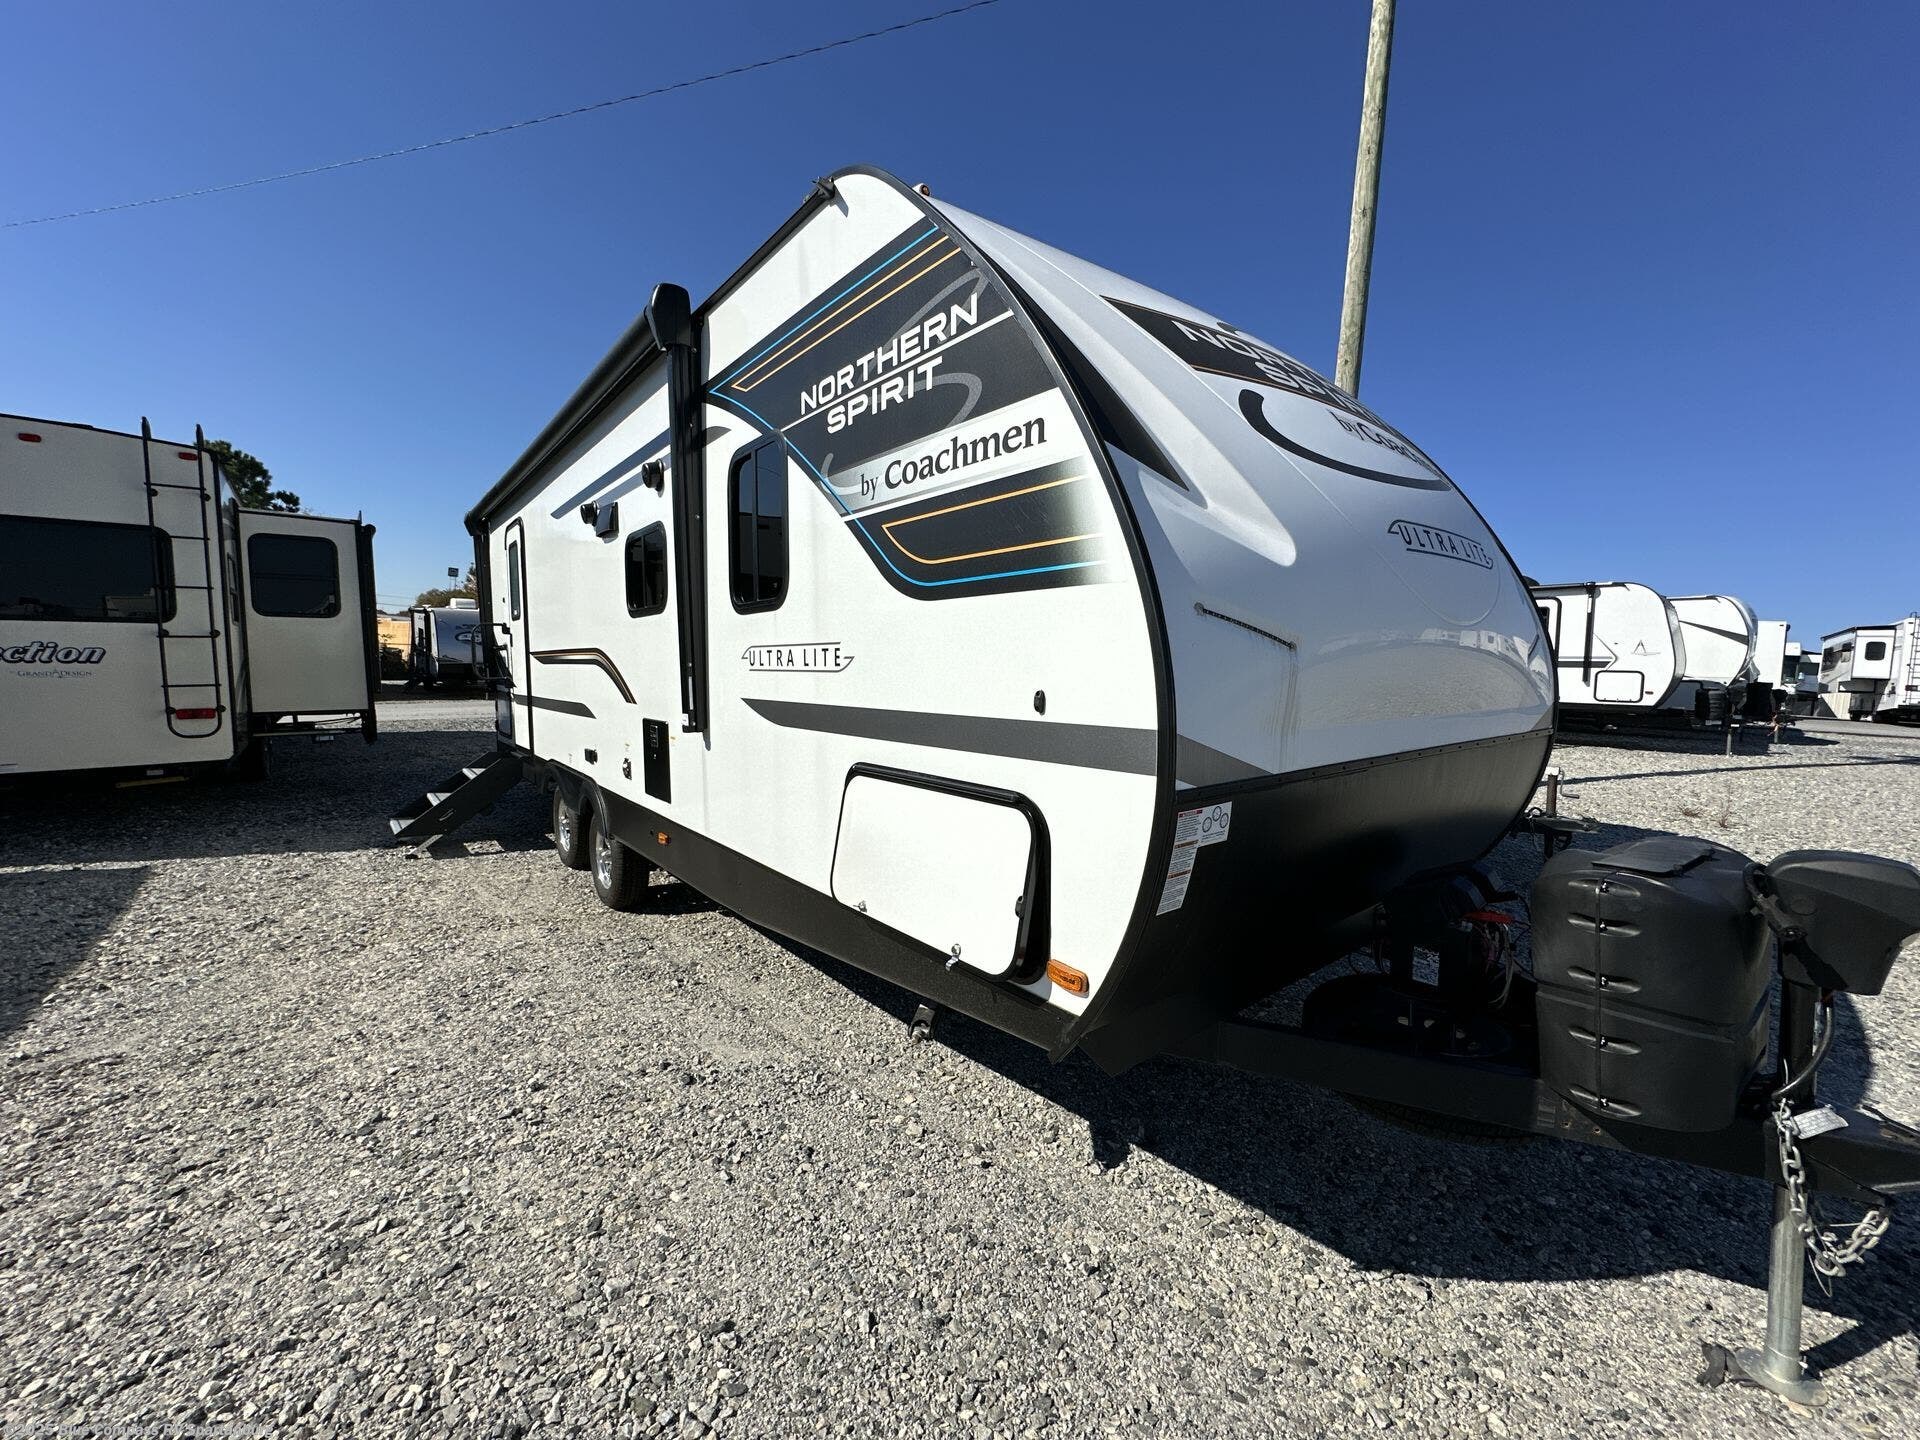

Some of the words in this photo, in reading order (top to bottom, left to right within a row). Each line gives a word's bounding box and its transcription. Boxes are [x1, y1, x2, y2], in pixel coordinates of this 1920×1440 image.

[801, 292, 978, 415] NORTHERN
[827, 356, 943, 434] SPIRIT
[861, 474, 878, 501] by
[884, 416, 1047, 490] Coachmen
[1398, 524, 1459, 555] ULTRA
[1461, 540, 1490, 565] LITE
[0, 641, 106, 664] ction
[17, 669, 53, 677] GRAND
[60, 669, 92, 677] DESIGN
[749, 649, 794, 667] ULTRA
[803, 648, 841, 667] LITE
